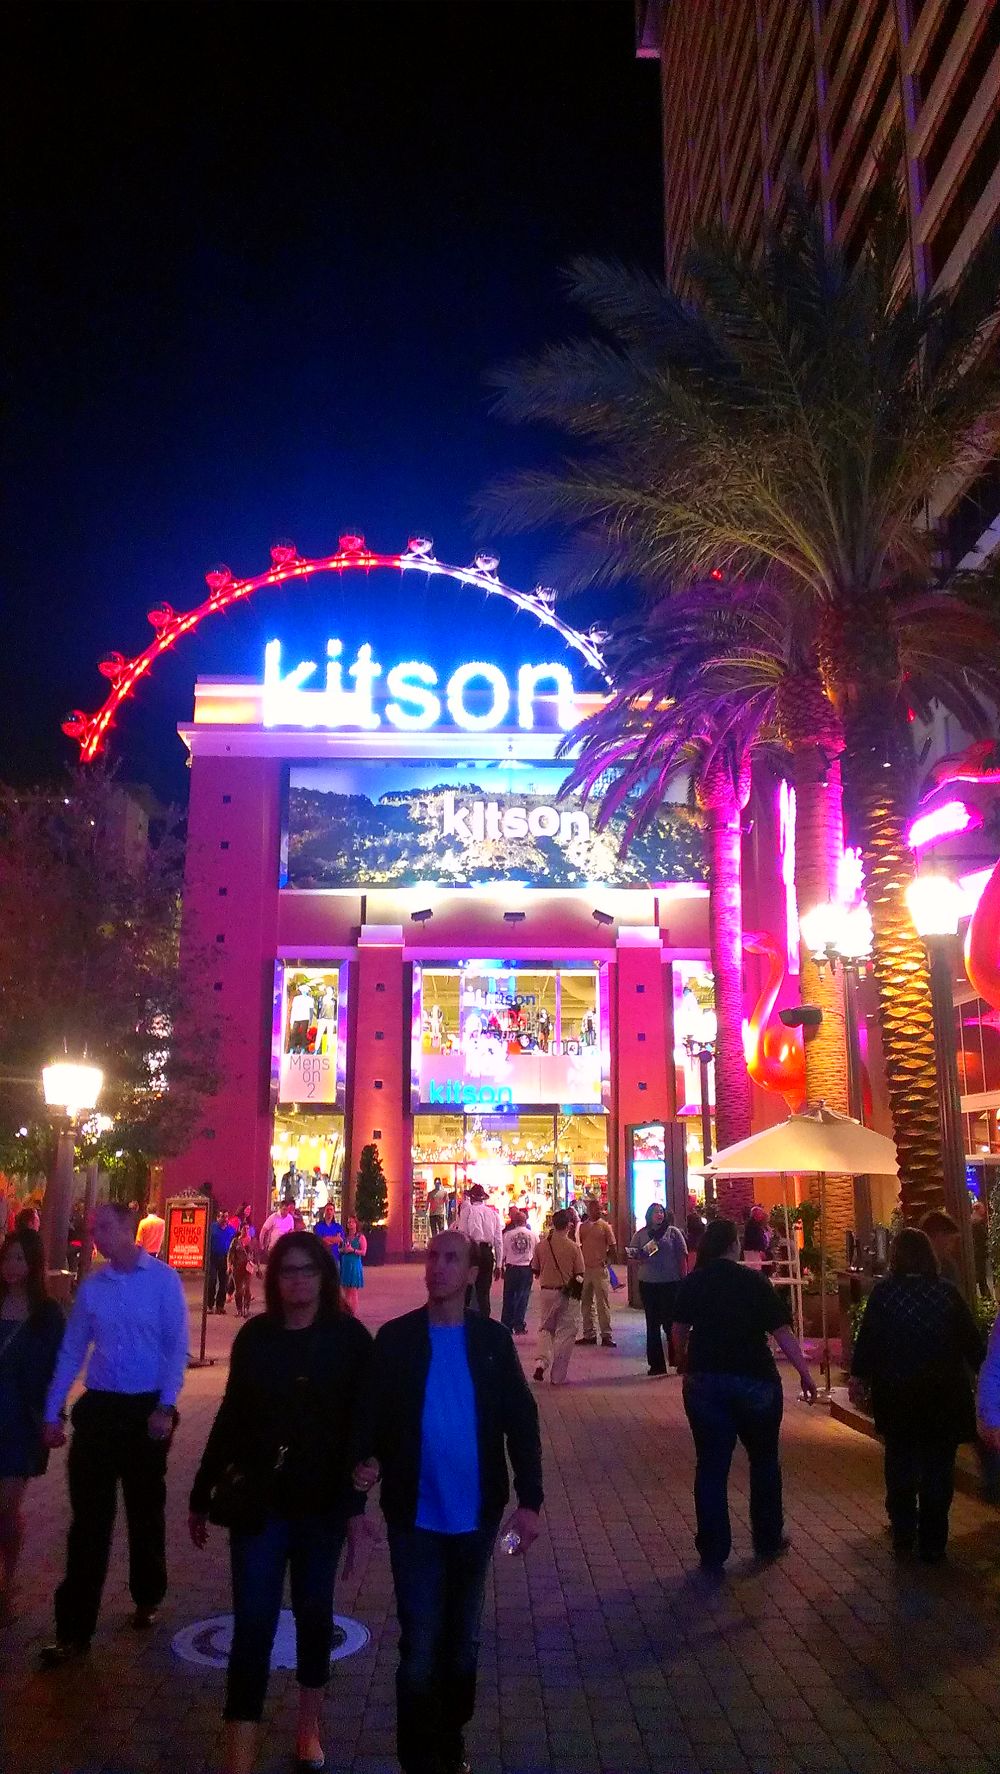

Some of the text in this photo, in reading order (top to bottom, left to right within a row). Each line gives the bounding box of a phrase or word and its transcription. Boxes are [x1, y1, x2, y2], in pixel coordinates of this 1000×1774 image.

[262, 638, 577, 731] kitson
[443, 790, 590, 840] kitson
[290, 1055, 330, 1070] Mens
[303, 1070, 320, 1082] on
[307, 1083, 315, 1098] 2
[429, 1079, 513, 1104] kitson
